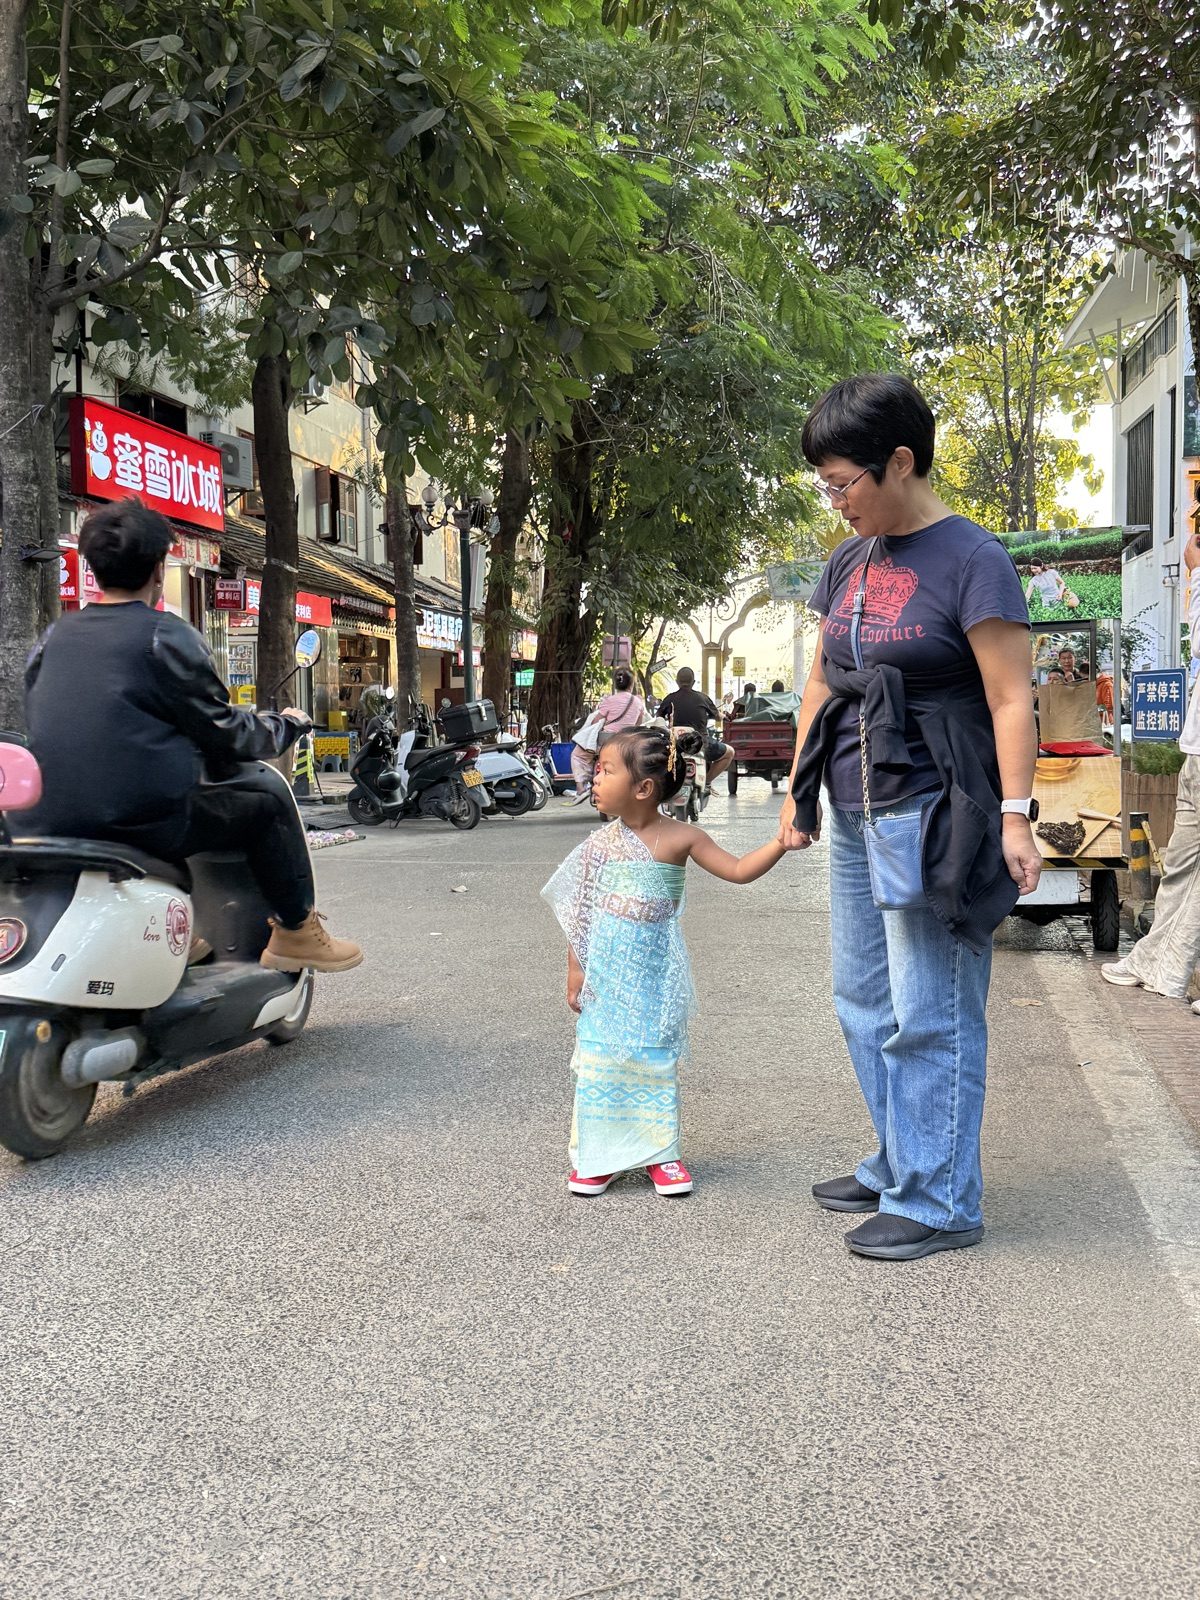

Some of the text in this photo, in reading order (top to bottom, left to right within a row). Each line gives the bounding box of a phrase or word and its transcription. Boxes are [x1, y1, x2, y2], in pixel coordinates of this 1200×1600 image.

[113, 432, 222, 516] 蜜雪冰城
[216, 591, 241, 601] 便利店
[860, 624, 927, 643] Couture
[1136, 680, 1180, 703] 严禁停车
[1136, 710, 1180, 732] 监控抓拍
[86, 980, 115, 996] 爱玛
